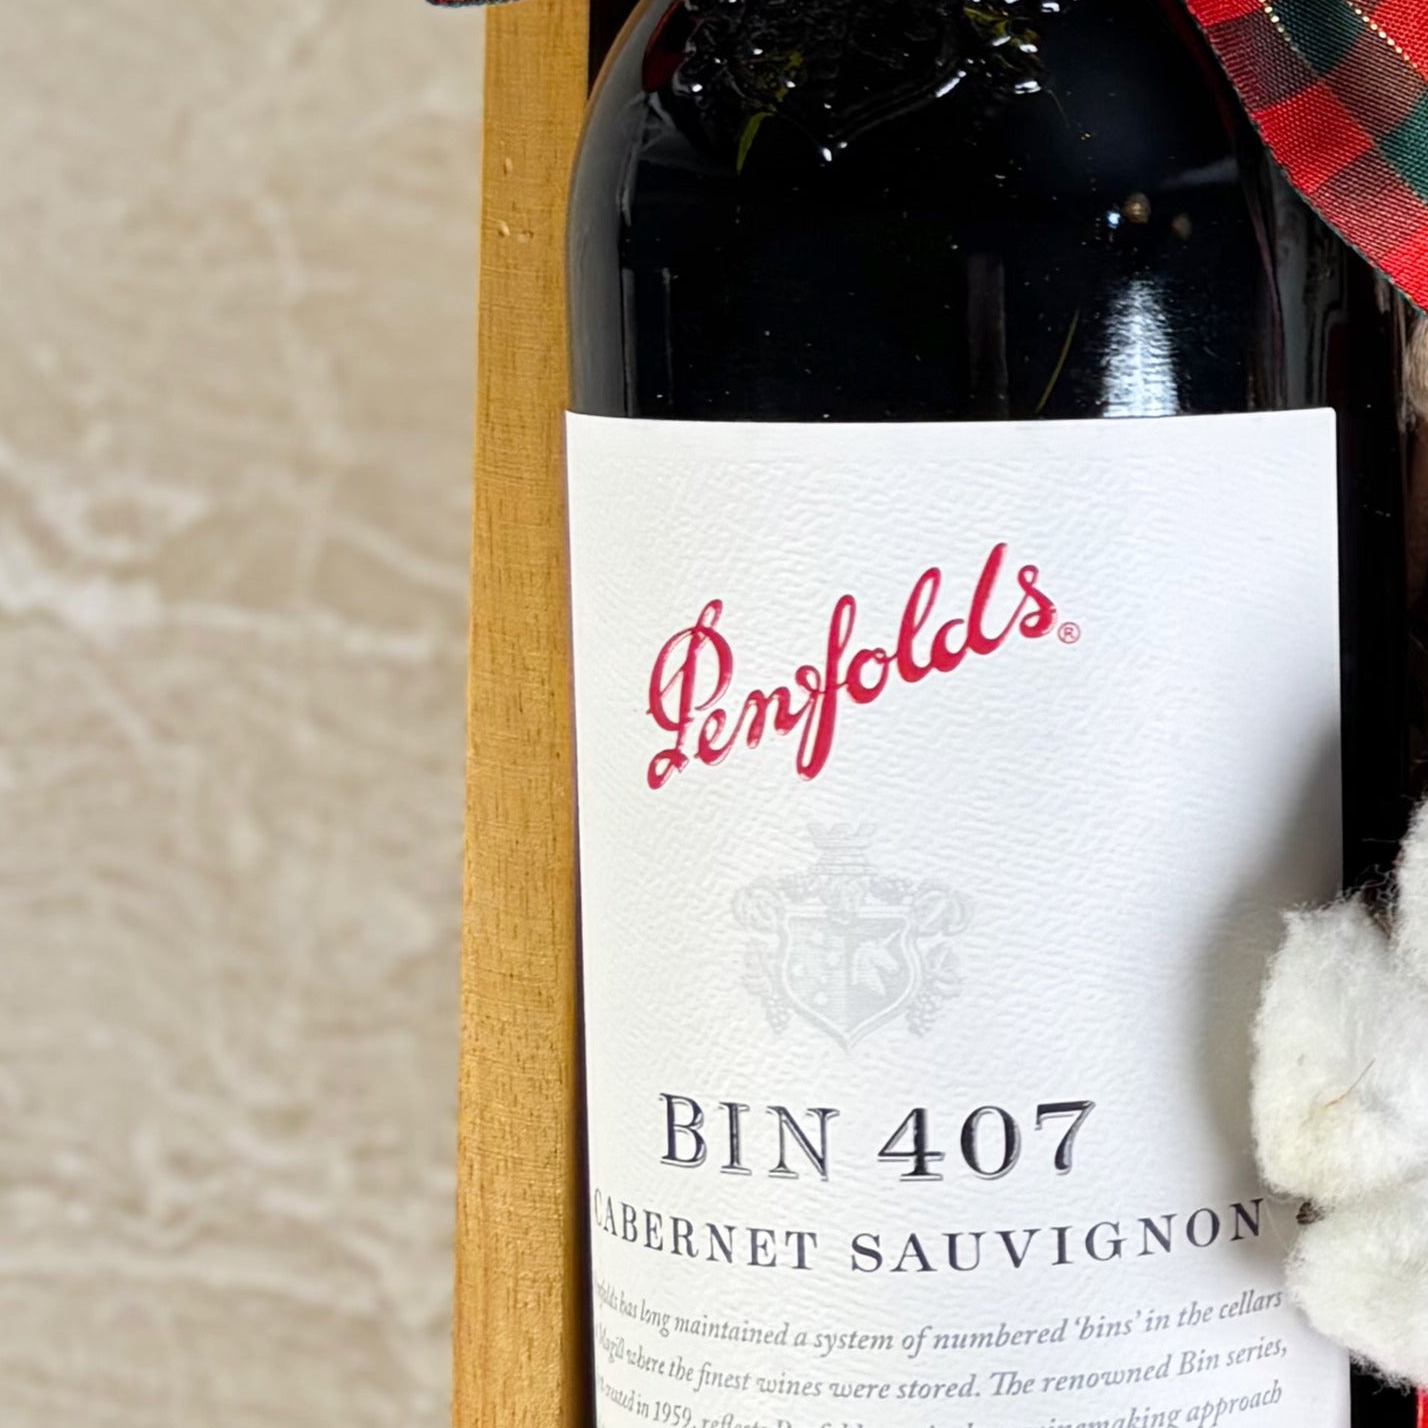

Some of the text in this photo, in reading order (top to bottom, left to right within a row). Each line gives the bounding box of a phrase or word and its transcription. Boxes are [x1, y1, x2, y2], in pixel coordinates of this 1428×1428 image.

[646, 541, 1058, 790] Penfolds
[659, 1092, 1097, 1183] BIN 407
[594, 1188, 1264, 1272] CABERNET SAUVIGNON
[674, 1290, 1283, 1357] maintained system numbered cellars
[757, 1348, 1220, 1400] wines were stored. The renowned Bin
